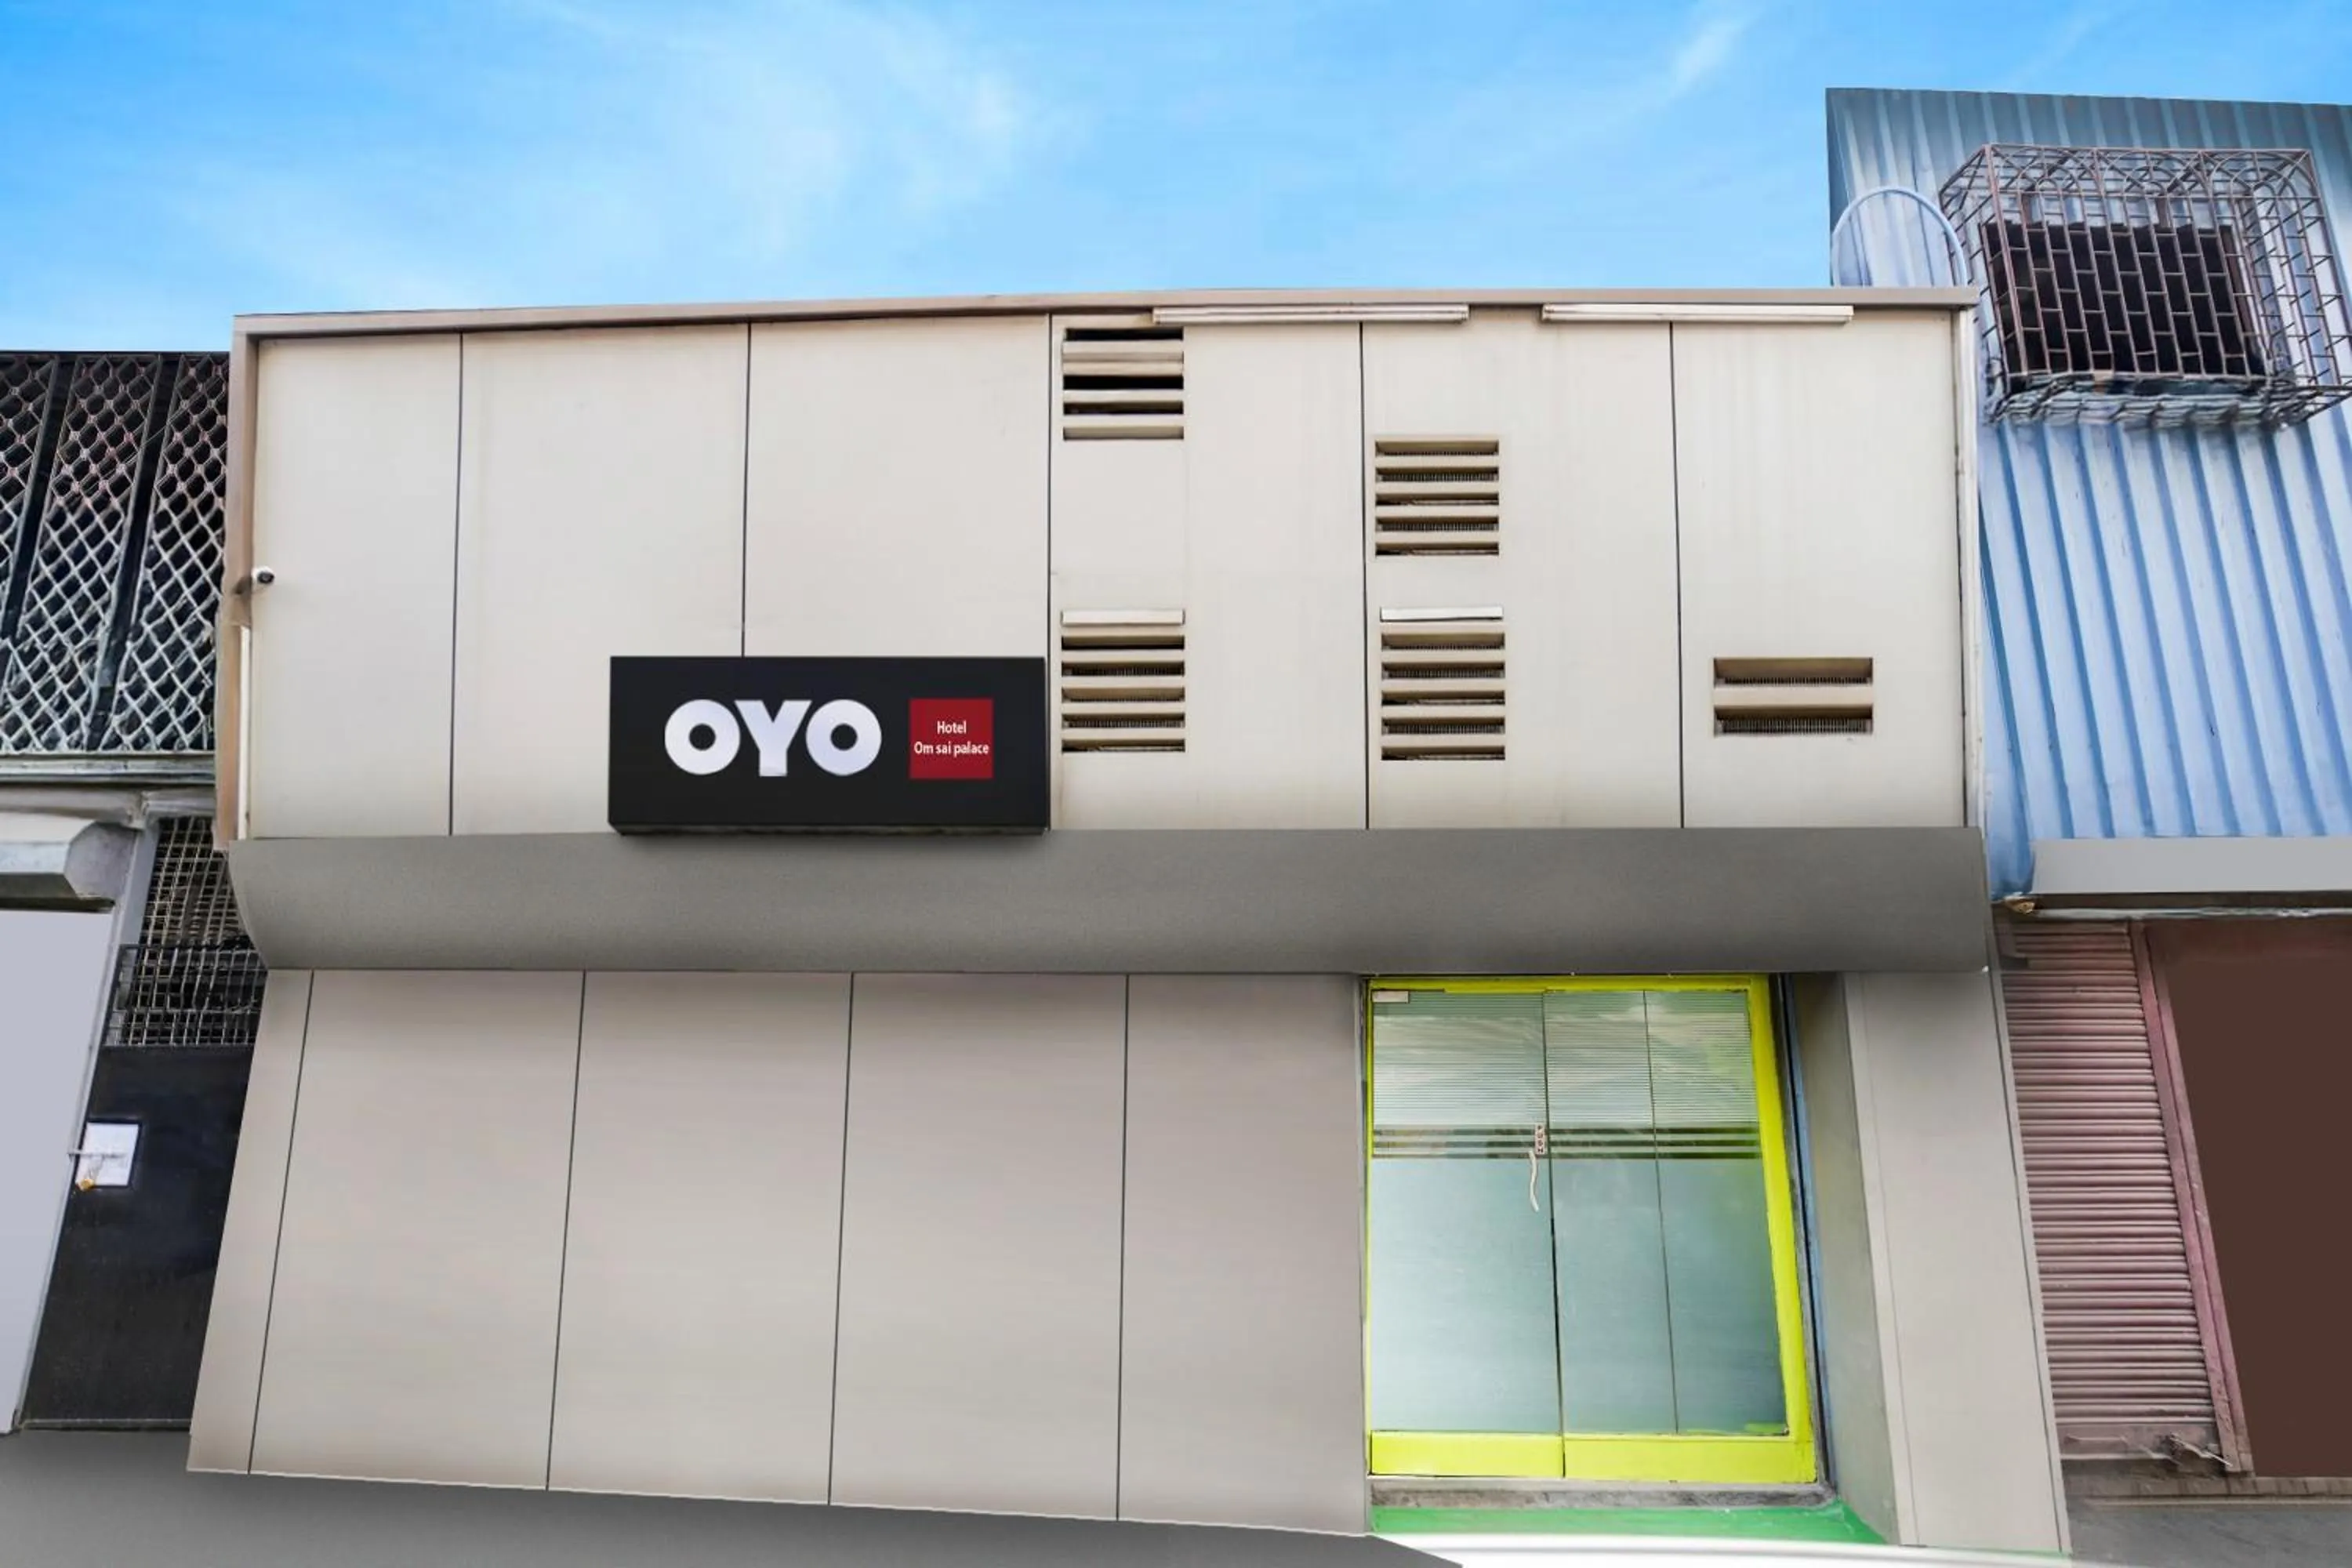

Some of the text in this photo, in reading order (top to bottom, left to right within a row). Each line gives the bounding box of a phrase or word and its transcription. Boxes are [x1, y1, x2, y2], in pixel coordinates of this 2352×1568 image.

[937, 720, 967, 734] Hotel
[665, 699, 882, 777] OYO
[914, 740, 989, 758] Om sai palace
